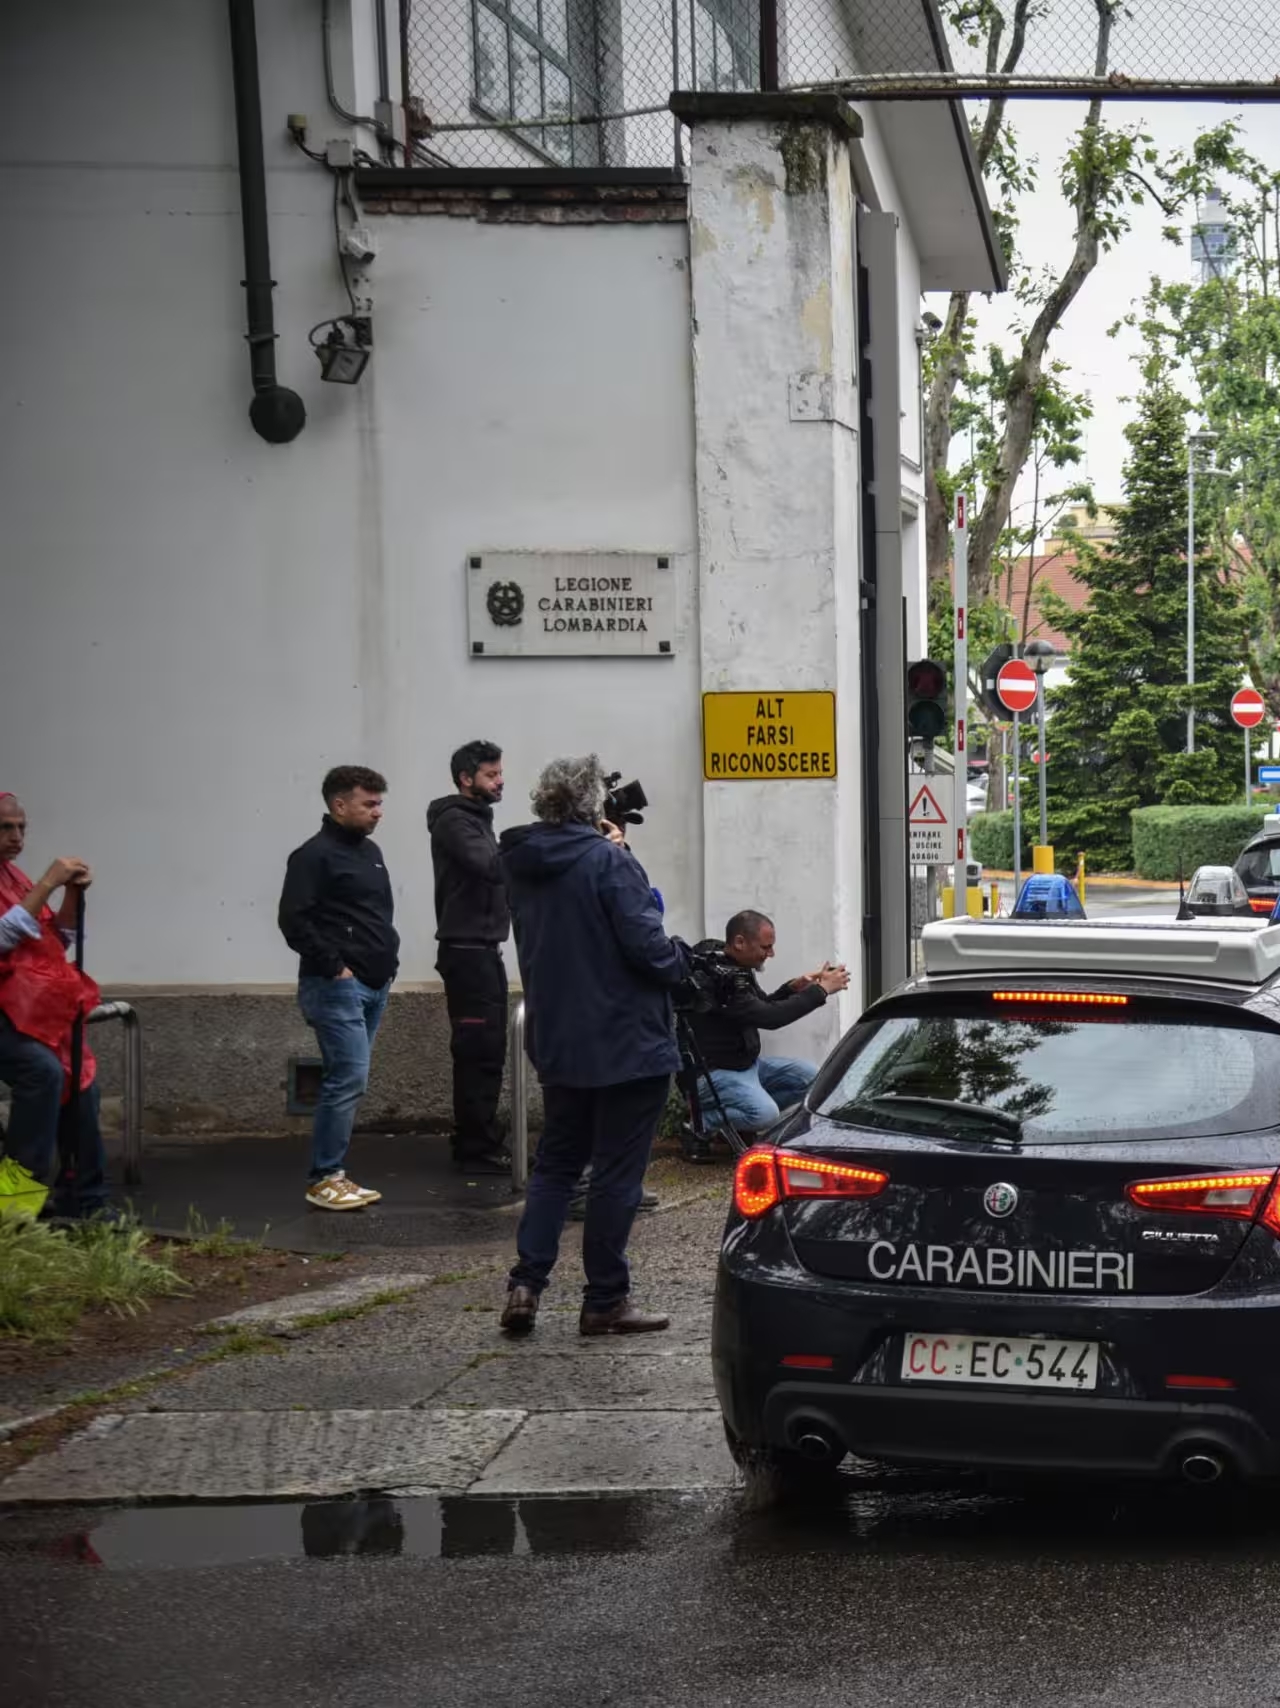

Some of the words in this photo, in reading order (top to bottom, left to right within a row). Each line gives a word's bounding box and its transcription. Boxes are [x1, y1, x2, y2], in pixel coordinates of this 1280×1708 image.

[555, 577, 632, 592] LEGIONE
[537, 597, 653, 612] CARABINIERI
[543, 618, 648, 632] LOMBARDIA
[756, 698, 784, 718] ALT
[746, 725, 794, 746] FARSI
[711, 752, 831, 773] RICONOSCERE
[910, 831, 942, 839] NTRARE
[916, 842, 942, 850] USCIRE
[1142, 1230, 1219, 1241] GIULIETTA
[867, 1240, 1134, 1290] CARABINIERI
[909, 1338, 949, 1374] CC
[970, 1341, 1011, 1378] EC
[1026, 1344, 1091, 1383] 544
